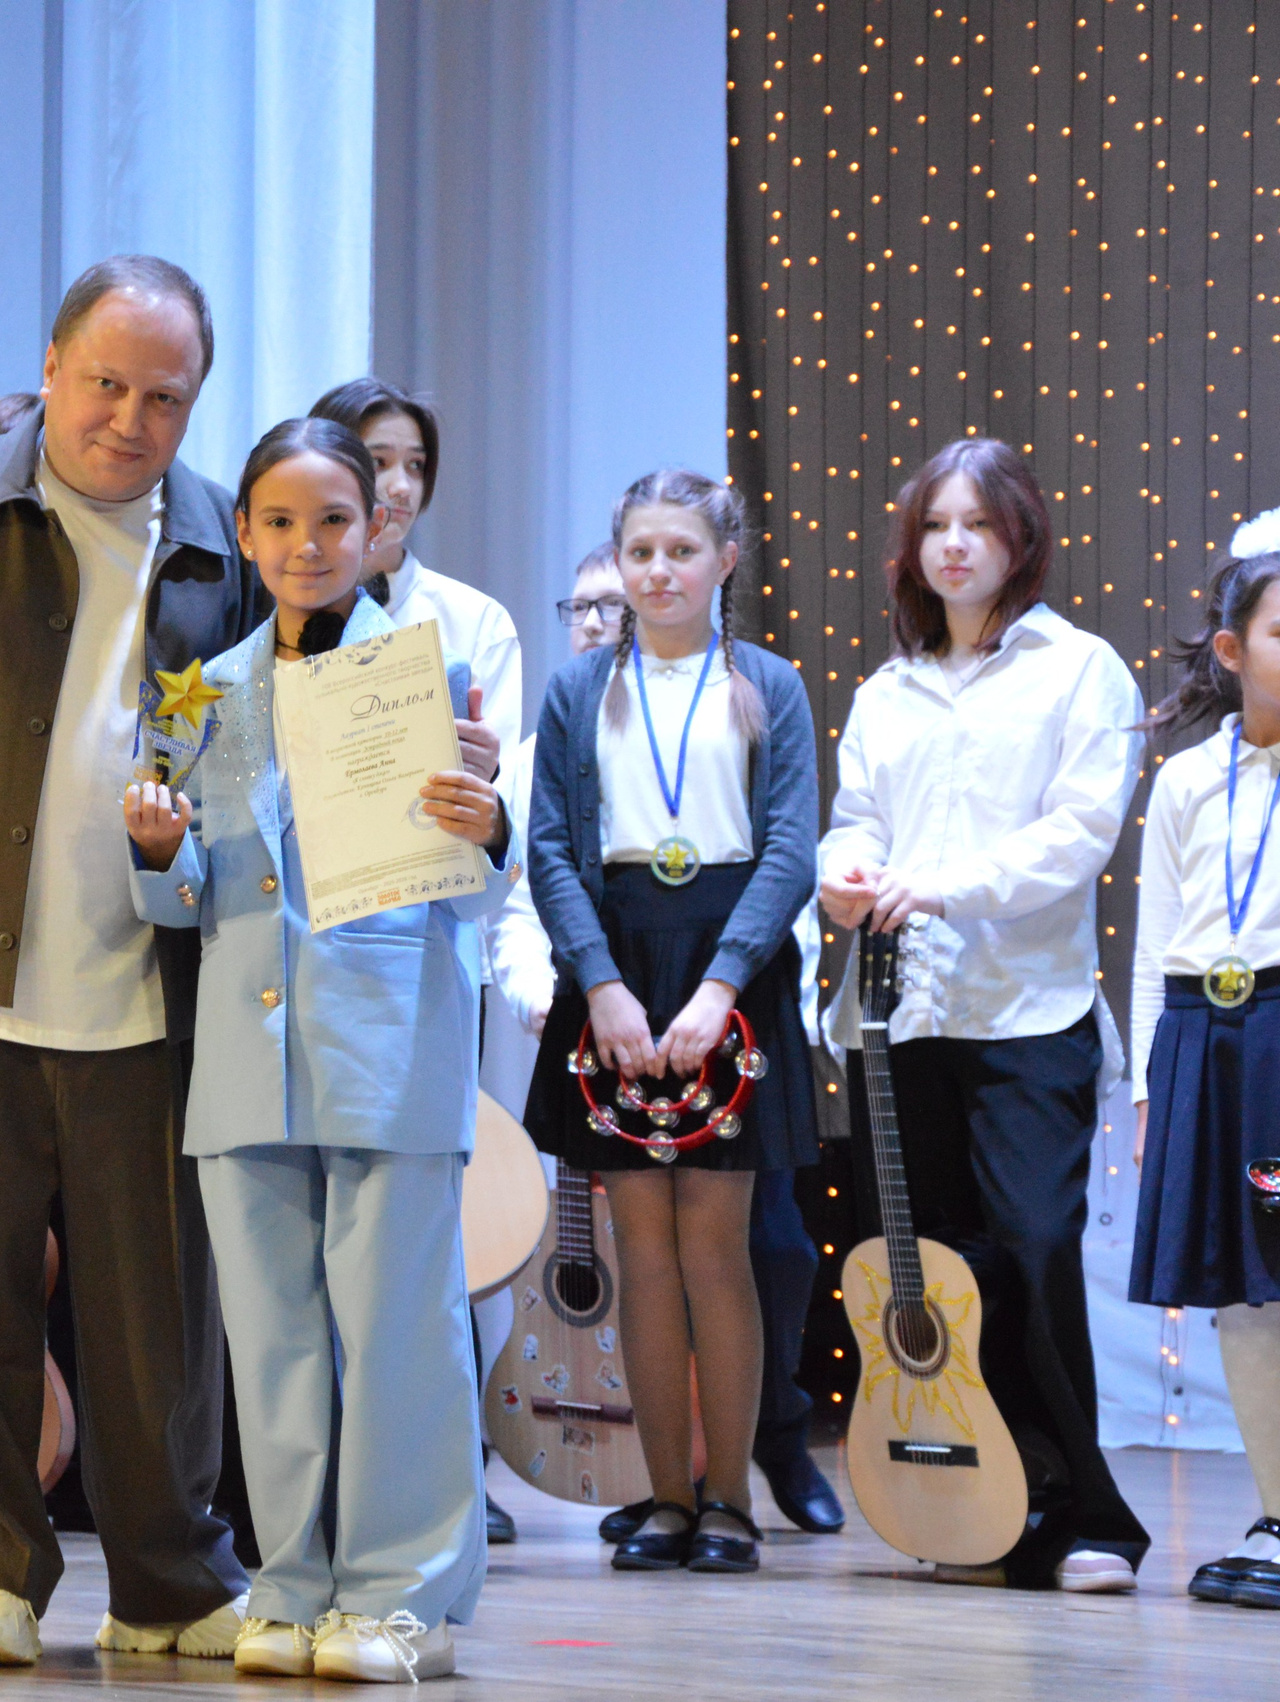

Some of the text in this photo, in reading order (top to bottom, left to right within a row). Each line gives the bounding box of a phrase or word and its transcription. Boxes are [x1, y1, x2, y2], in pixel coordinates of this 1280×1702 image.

[350, 688, 435, 722] Диплом
[145, 730, 196, 752] СЧАСТЛИВАЯ
[154, 742, 182, 755] ЗВЕЗДА
[344, 756, 395, 779] Ермолаева Анна
[346, 748, 390, 767] награждается
